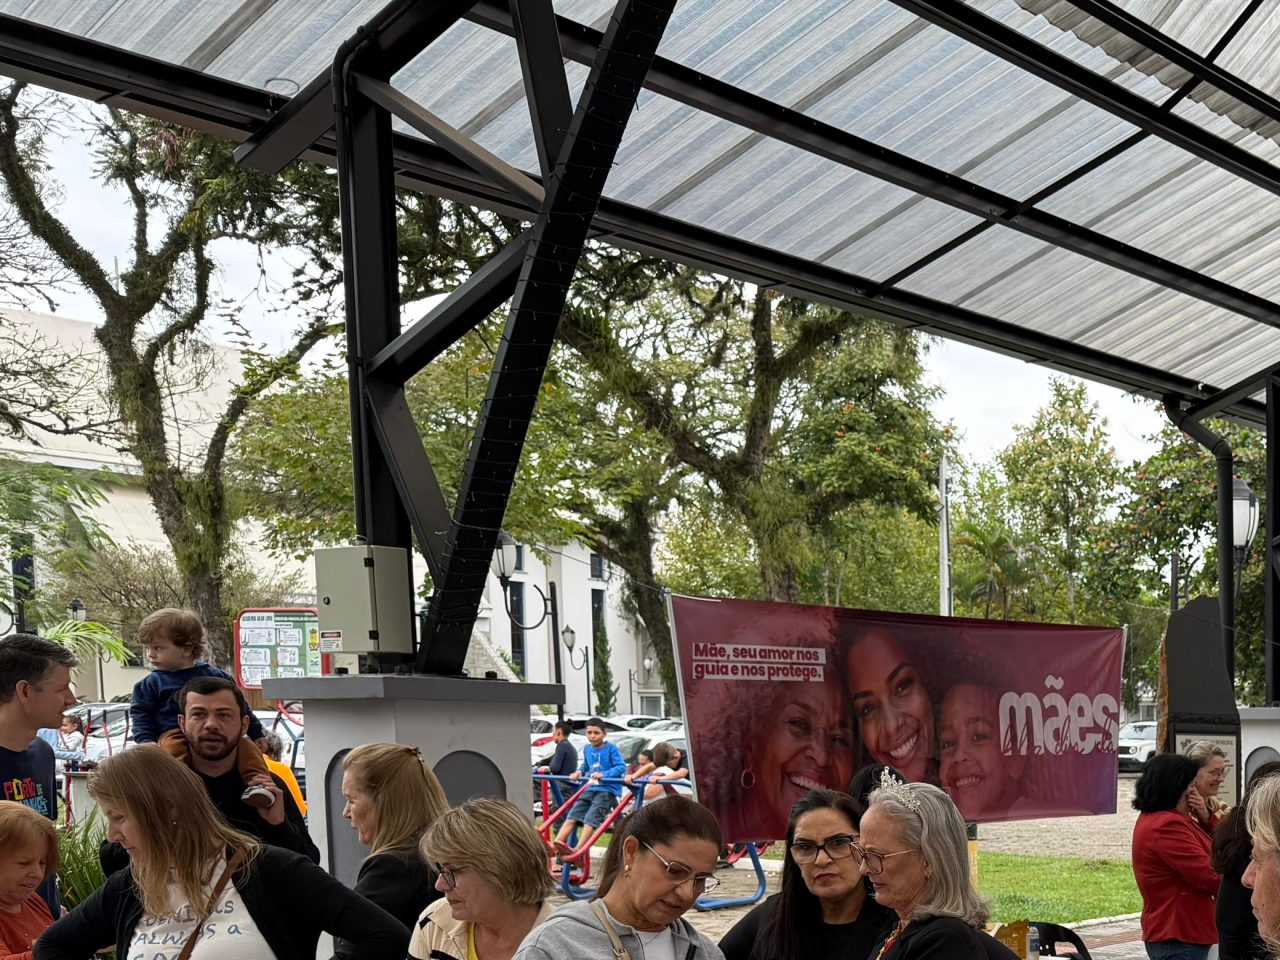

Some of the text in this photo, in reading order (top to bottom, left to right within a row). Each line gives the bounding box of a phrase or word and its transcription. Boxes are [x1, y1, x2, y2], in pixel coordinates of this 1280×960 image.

[694, 643, 819, 661] Mãe, seu amor nos
[694, 661, 822, 681] guia e nos protege.
[999, 675, 1119, 755] mães
[3, 777, 36, 800] PORTO
